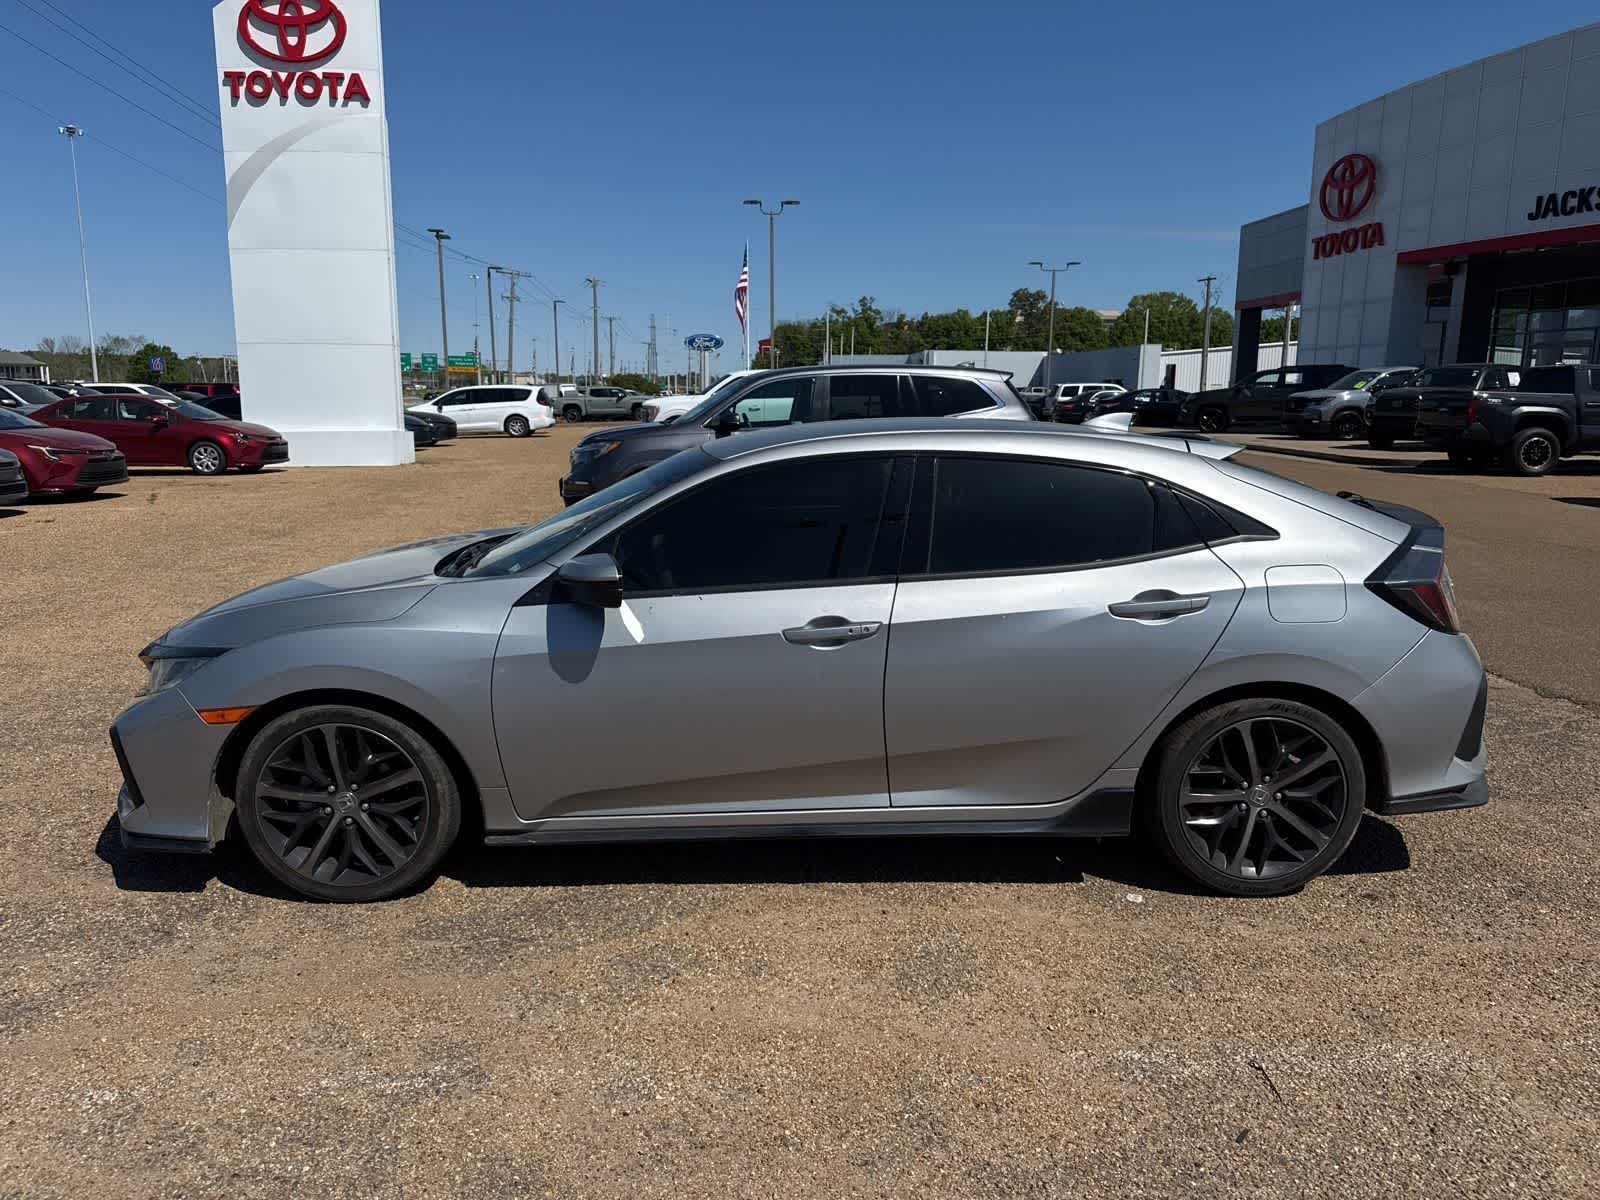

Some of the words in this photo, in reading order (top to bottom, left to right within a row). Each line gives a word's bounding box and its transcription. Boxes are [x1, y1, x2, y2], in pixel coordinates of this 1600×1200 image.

[223, 70, 371, 101] TOYOTA
[1312, 222, 1385, 260] TOYOTA
[692, 336, 717, 349] Ford
